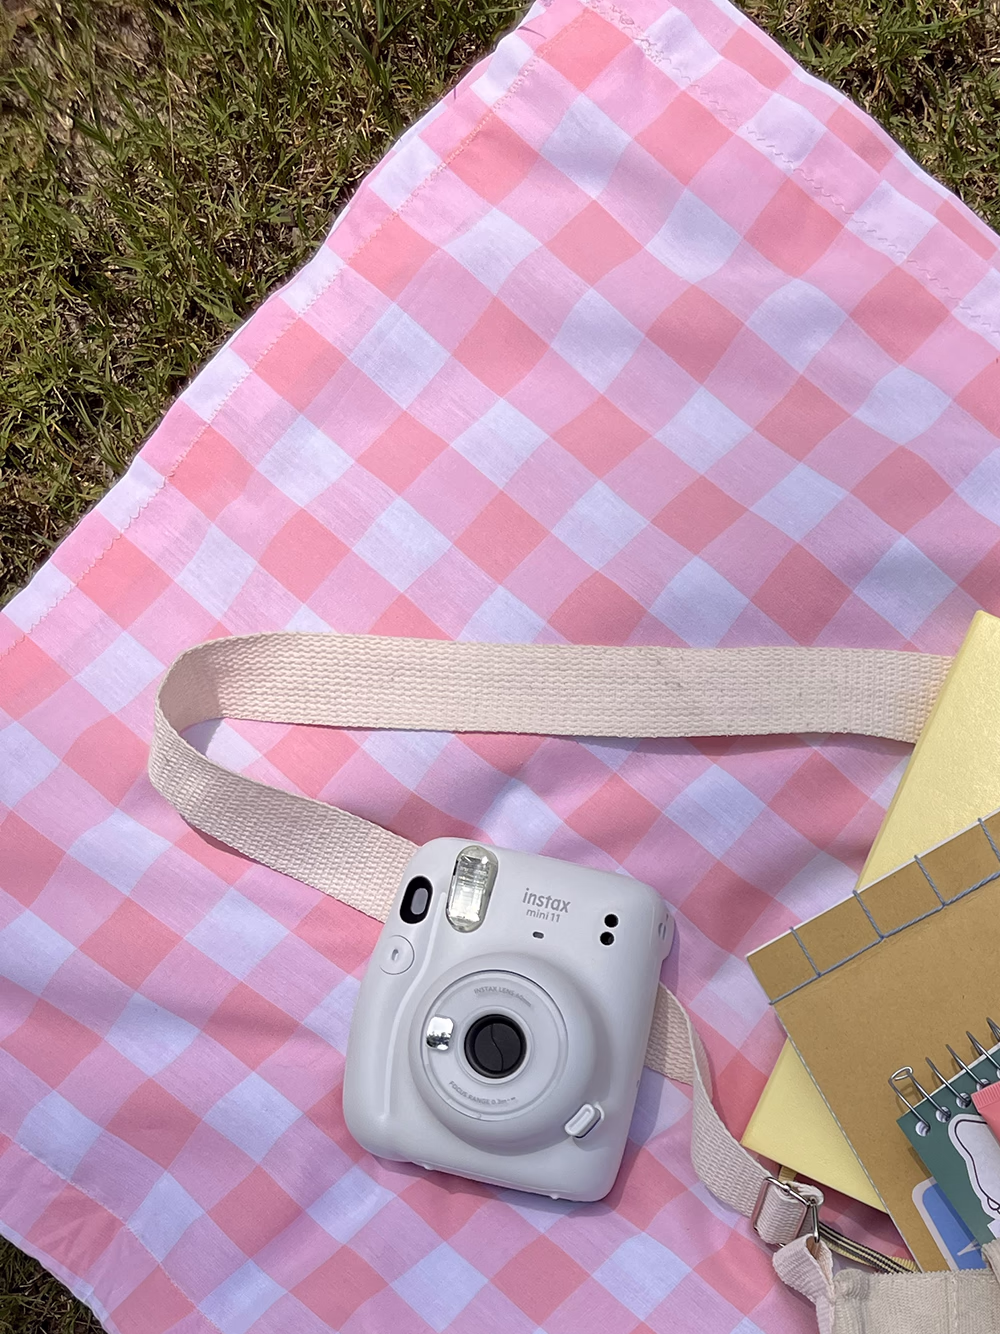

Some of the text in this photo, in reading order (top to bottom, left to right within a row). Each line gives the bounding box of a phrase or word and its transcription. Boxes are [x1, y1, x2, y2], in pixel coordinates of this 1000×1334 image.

[522, 887, 571, 913] instax
[526, 909, 561, 923] mini 11
[473, 986, 498, 994] INSTAX
